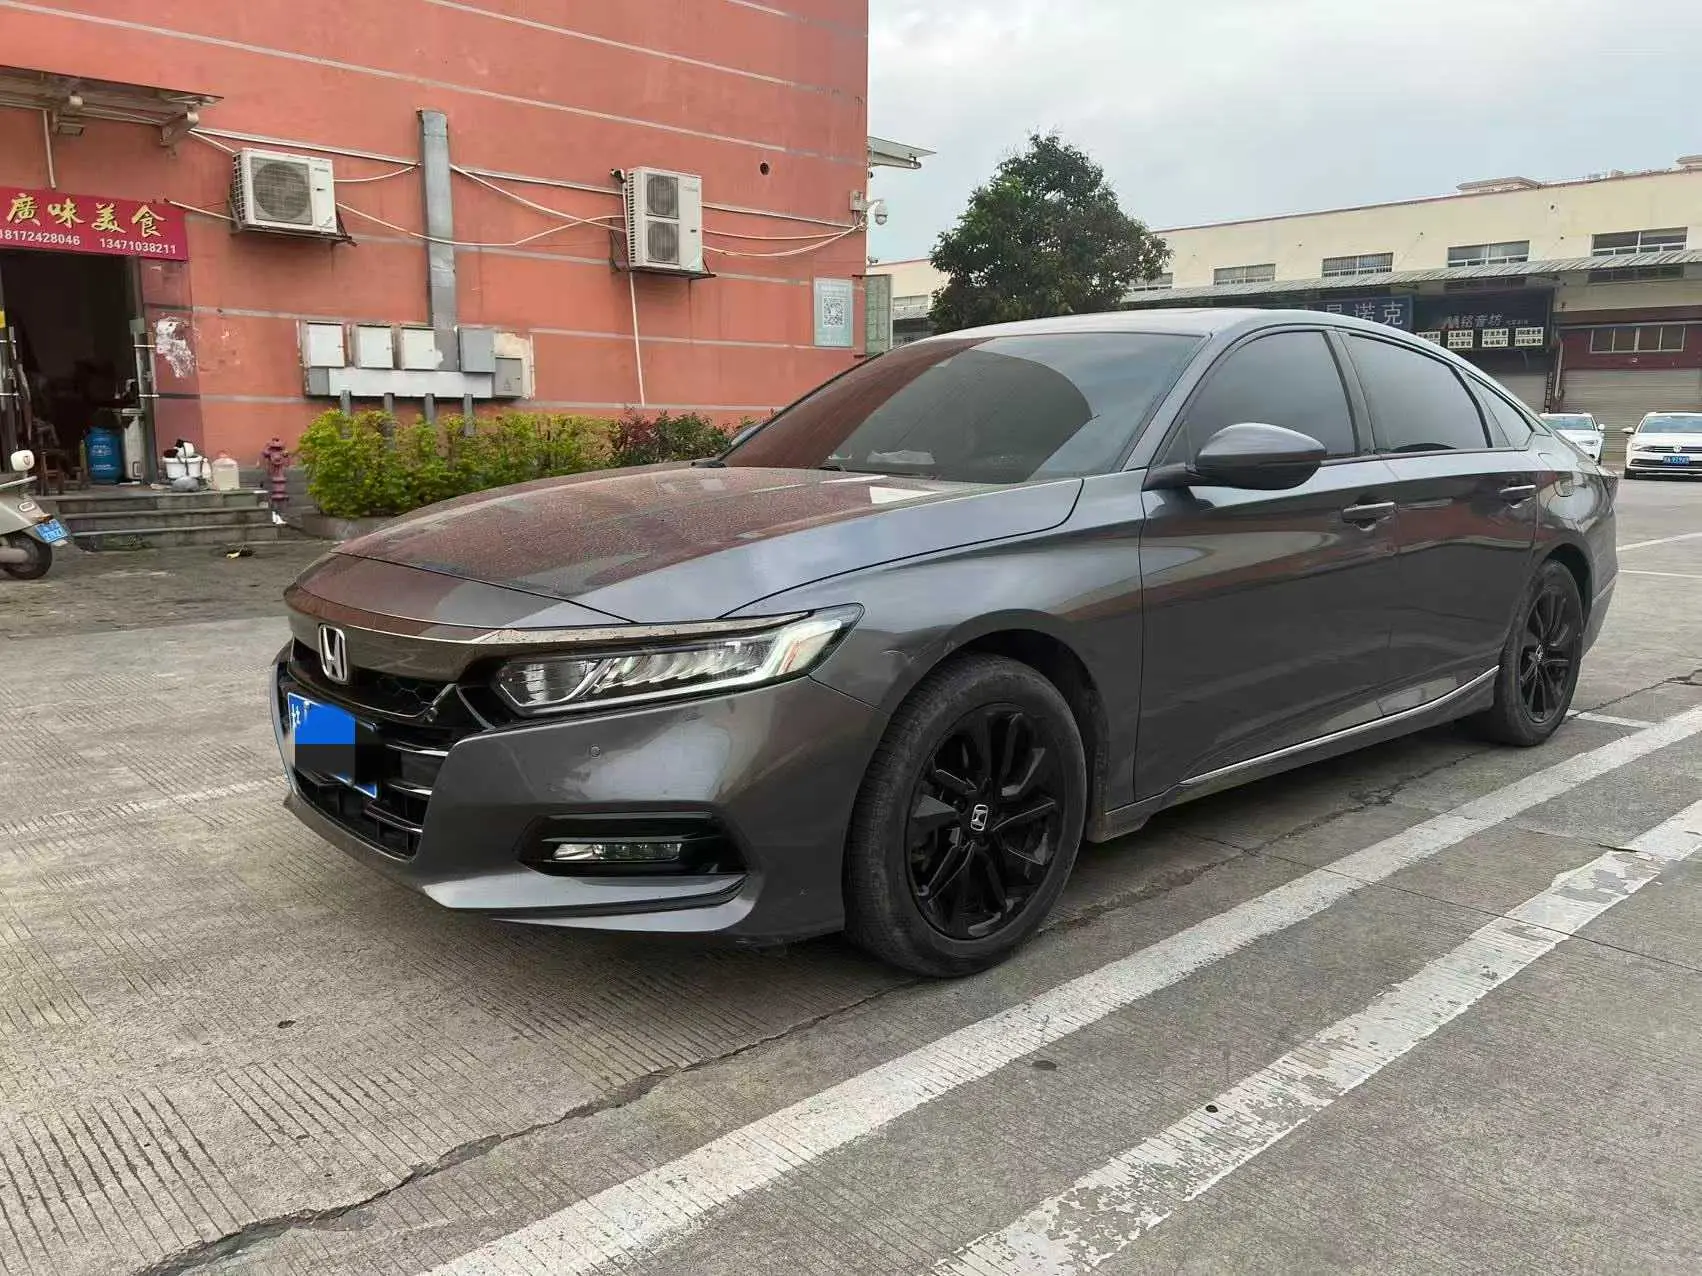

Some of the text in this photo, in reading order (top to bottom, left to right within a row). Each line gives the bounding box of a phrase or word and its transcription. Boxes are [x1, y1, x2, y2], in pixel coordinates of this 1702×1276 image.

[6, 193, 166, 238] 廣味美食
[0, 229, 176, 255] 18172428046 13471038211
